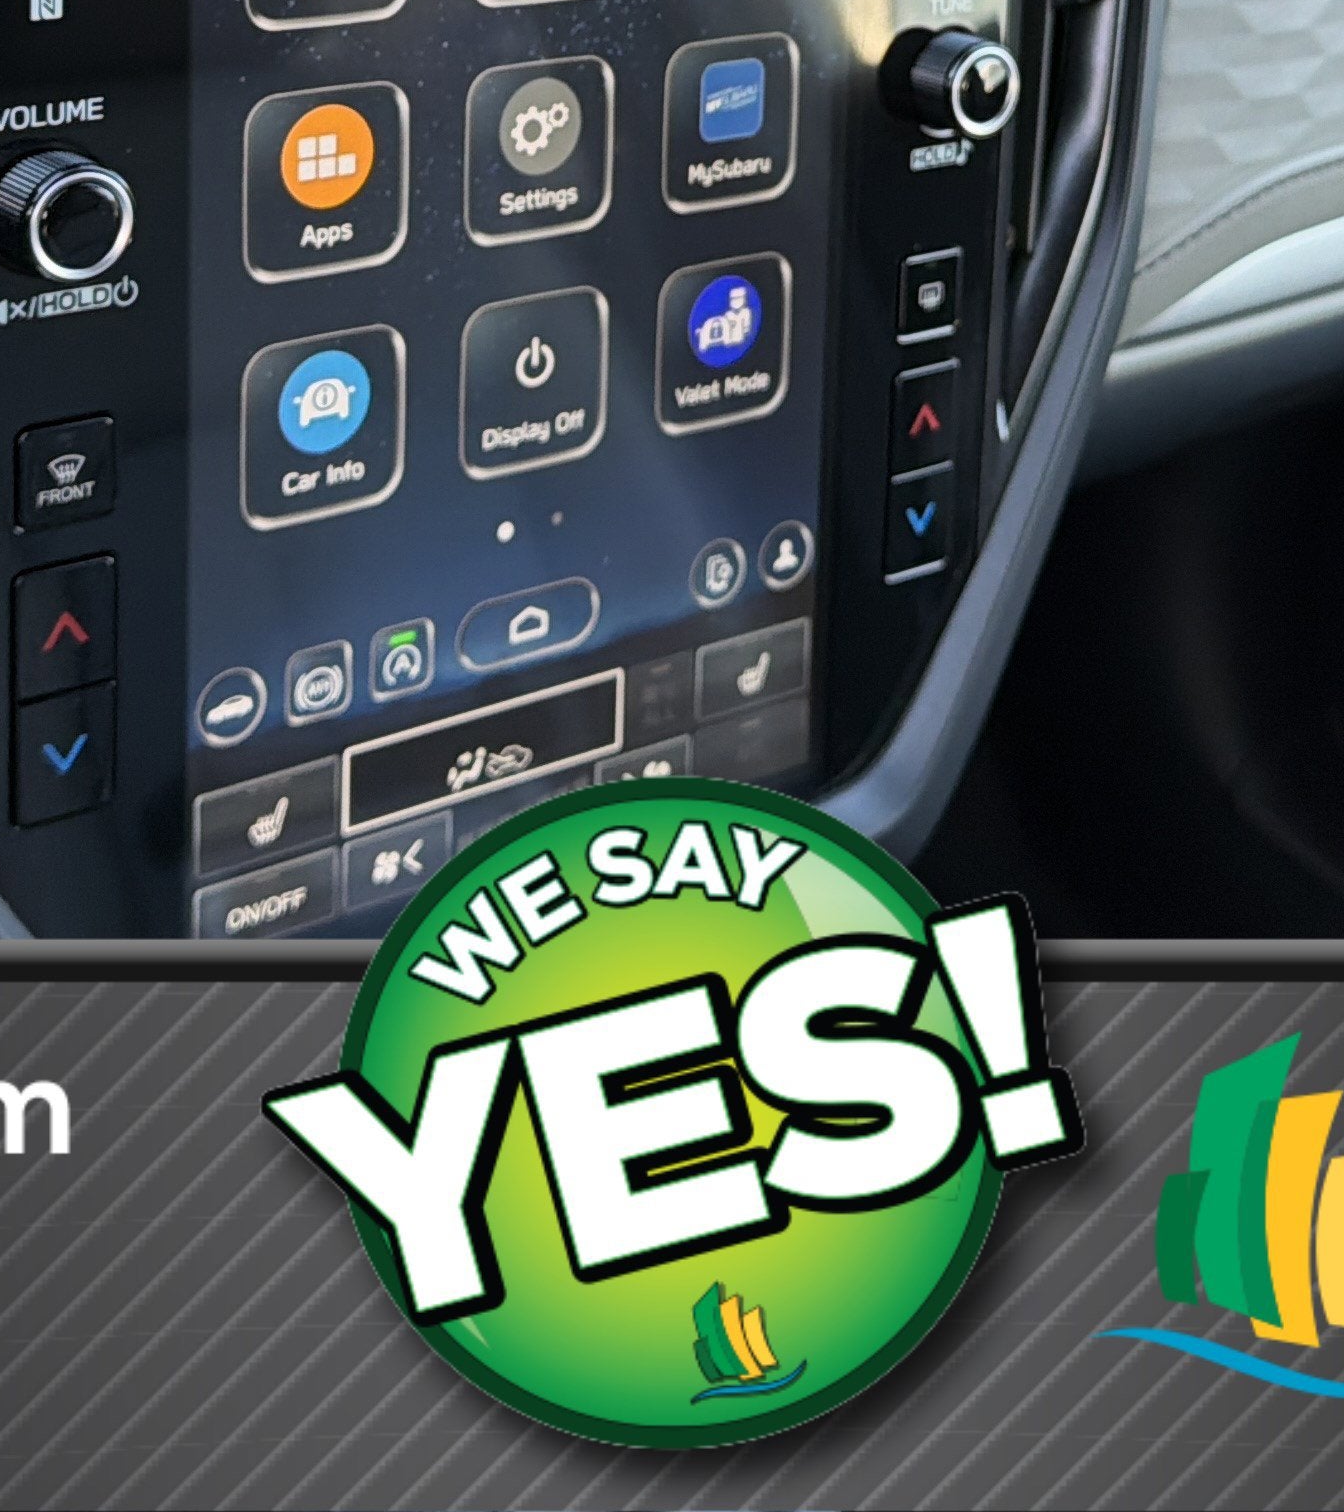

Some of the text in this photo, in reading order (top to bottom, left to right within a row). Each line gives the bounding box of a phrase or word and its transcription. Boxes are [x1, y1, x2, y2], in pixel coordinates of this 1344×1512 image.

[687, 157, 772, 188] MySubaru
[500, 184, 578, 216] Settings
[301, 220, 353, 249] Apps
[675, 370, 771, 408] Valet Mode
[482, 408, 585, 452] Display Off
[36, 480, 96, 509] FRONT
[282, 459, 366, 496] Car Info
[225, 887, 307, 935] ON/OFF
